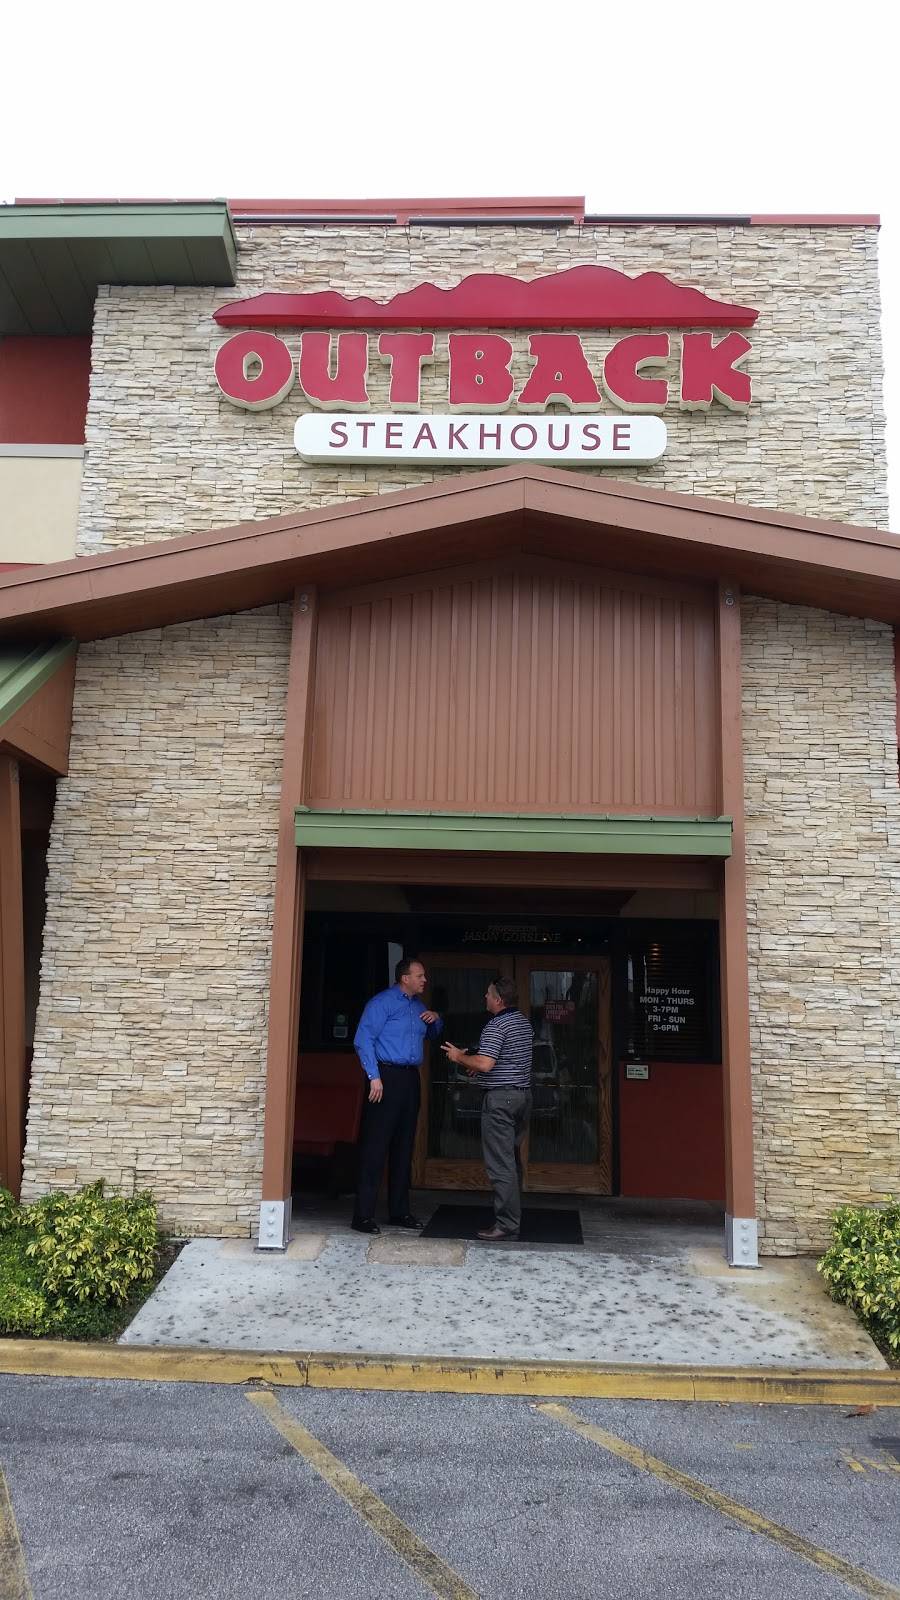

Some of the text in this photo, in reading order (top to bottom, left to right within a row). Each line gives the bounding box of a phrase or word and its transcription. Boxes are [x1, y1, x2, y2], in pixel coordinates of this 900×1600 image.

[213, 330, 752, 411] OUTBACK
[328, 421, 631, 451] STEAKHOUSE
[646, 986, 690, 995] Happy Hour
[667, 997, 695, 1005] THURS
[653, 1005, 678, 1013] 3-7PM
